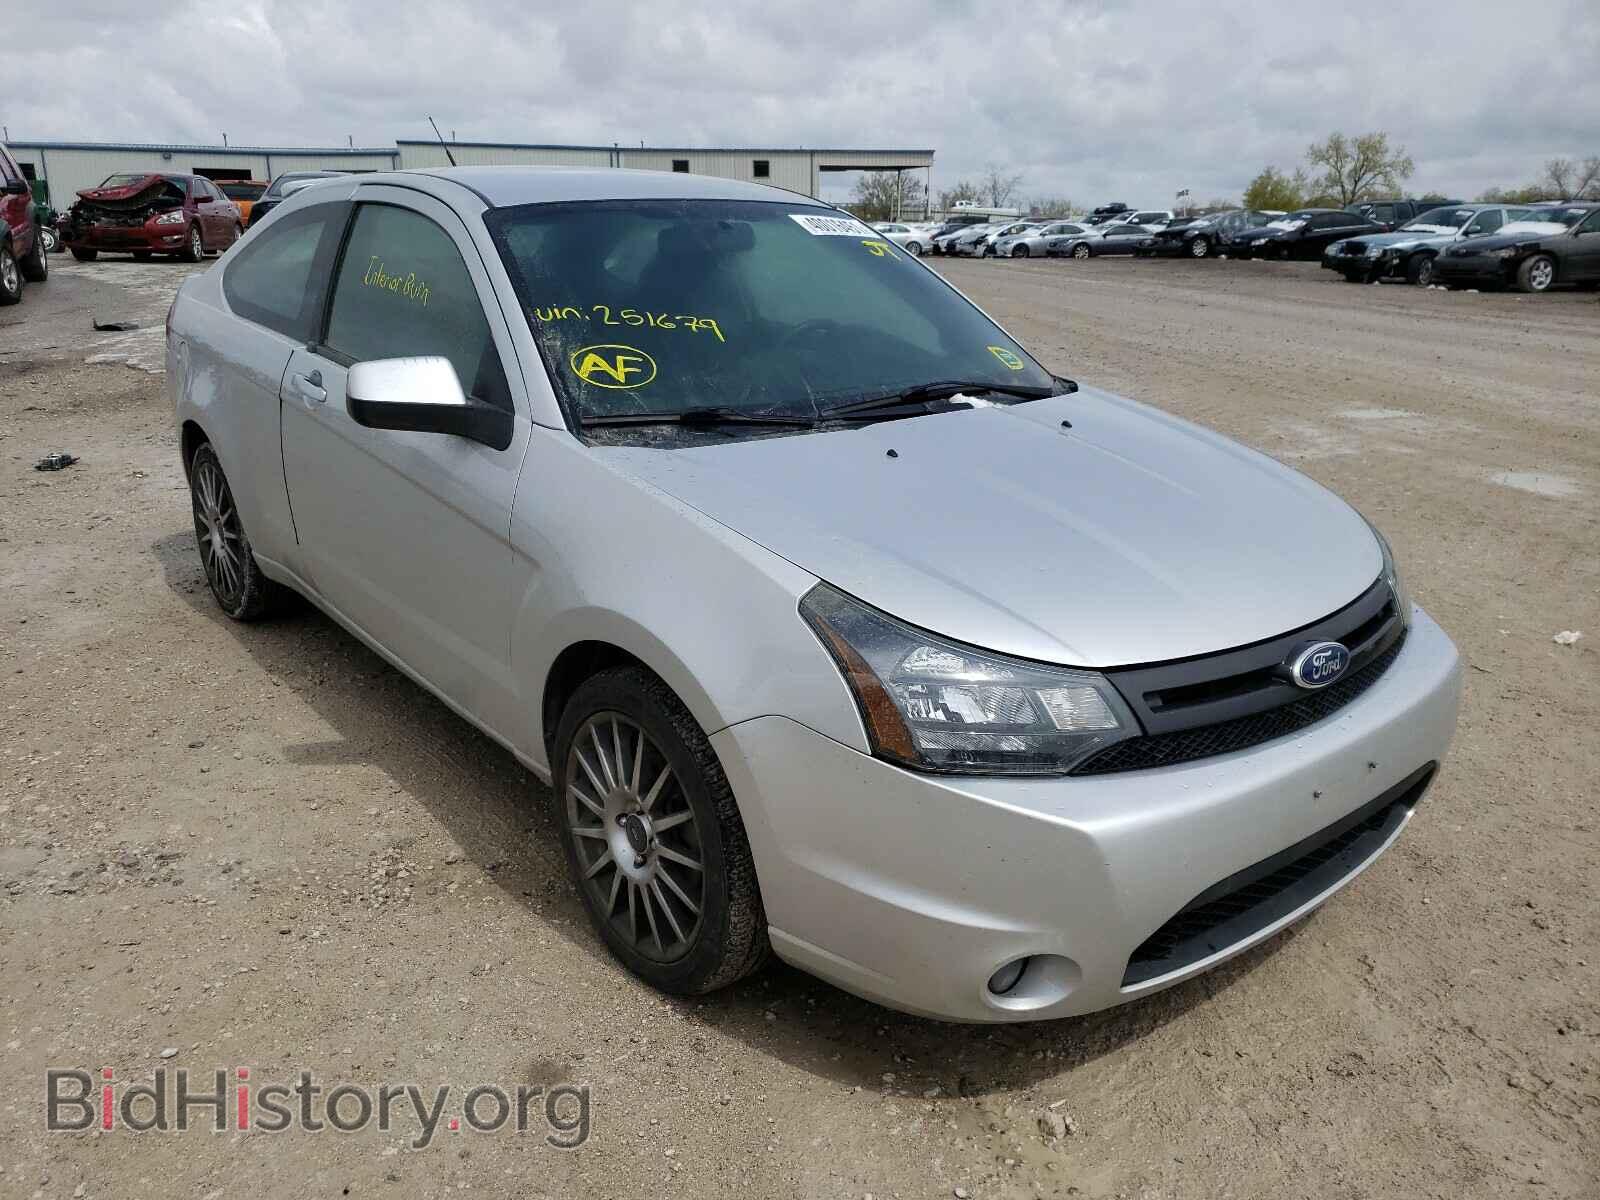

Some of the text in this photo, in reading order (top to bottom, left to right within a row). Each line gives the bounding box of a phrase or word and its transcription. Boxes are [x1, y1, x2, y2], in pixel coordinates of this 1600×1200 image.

[592, 305, 725, 343] 251679
[578, 352, 644, 384] AF
[1312, 650, 1341, 680] Ford
